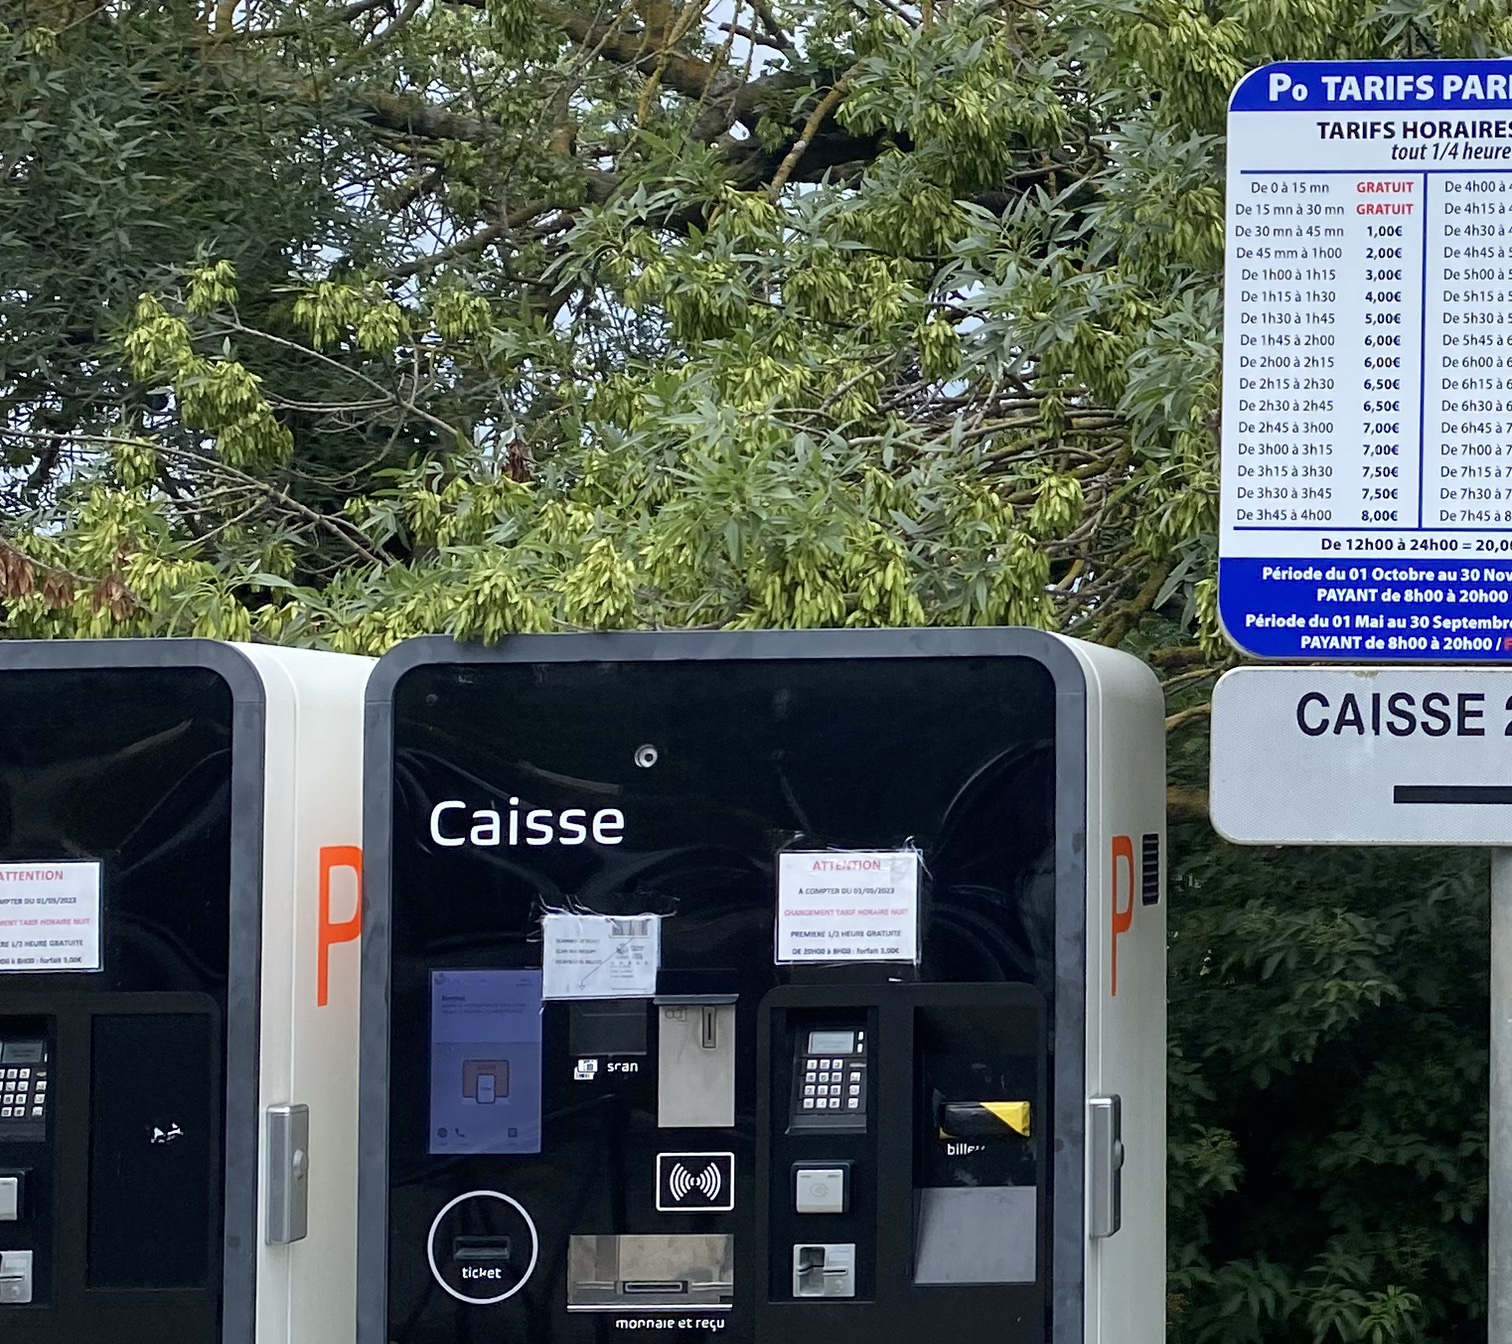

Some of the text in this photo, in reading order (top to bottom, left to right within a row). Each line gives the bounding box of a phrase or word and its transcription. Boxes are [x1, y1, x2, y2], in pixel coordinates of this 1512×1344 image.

[1321, 75, 1434, 101] TARIFS
[1316, 121, 1396, 140] TARIFS
[1391, 144, 1428, 161] tout
[1432, 142, 1459, 161] 1/4
[1462, 141, 1512, 160] heure
[1251, 181, 1414, 194] De 0 à 15 mn GRATUIT
[1443, 246, 1461, 259] De
[1463, 246, 1495, 259] 4h45
[1497, 246, 1505, 259] à
[1240, 355, 1401, 370] De 2h00 à 2h15 6,00€
[1440, 465, 1458, 478] De
[1460, 465, 1492, 478] 7h15
[1494, 466, 1502, 478] à
[1321, 538, 1342, 551] De
[1346, 537, 1394, 551] 12h00
[1397, 537, 1406, 551] à
[1409, 538, 1458, 552] 24h00
[1262, 566, 1323, 581] Période
[1325, 566, 1346, 581] du
[1348, 567, 1367, 581] 01
[1371, 567, 1435, 582] Octobre
[1437, 570, 1458, 582] au
[1460, 568, 1481, 582] 30
[1316, 588, 1379, 602] PAYANT
[1380, 588, 1401, 603] de
[1403, 588, 1444, 603] 8h00
[1446, 588, 1456, 603] à
[1458, 589, 1509, 603] 20h00
[1245, 613, 1306, 628] Période
[1308, 613, 1329, 628] du
[1332, 614, 1350, 628] 01
[1354, 614, 1384, 629] Mai
[1386, 618, 1407, 629] au
[1409, 615, 1430, 629] 30
[1300, 635, 1362, 650] PAYANT
[1364, 635, 1385, 650] de
[1387, 635, 1428, 650] 8h00
[1430, 635, 1440, 650] à
[1442, 636, 1493, 651] 20h00
[1296, 692, 1485, 737] CAISSE
[430, 796, 625, 847] Caisse
[812, 860, 881, 871] ATTENTION
[805, 887, 840, 895] COMPTER
[841, 887, 852, 895] DU
[462, 1266, 502, 1279] ticket
[615, 1318, 725, 1333] monnaie et reçu
